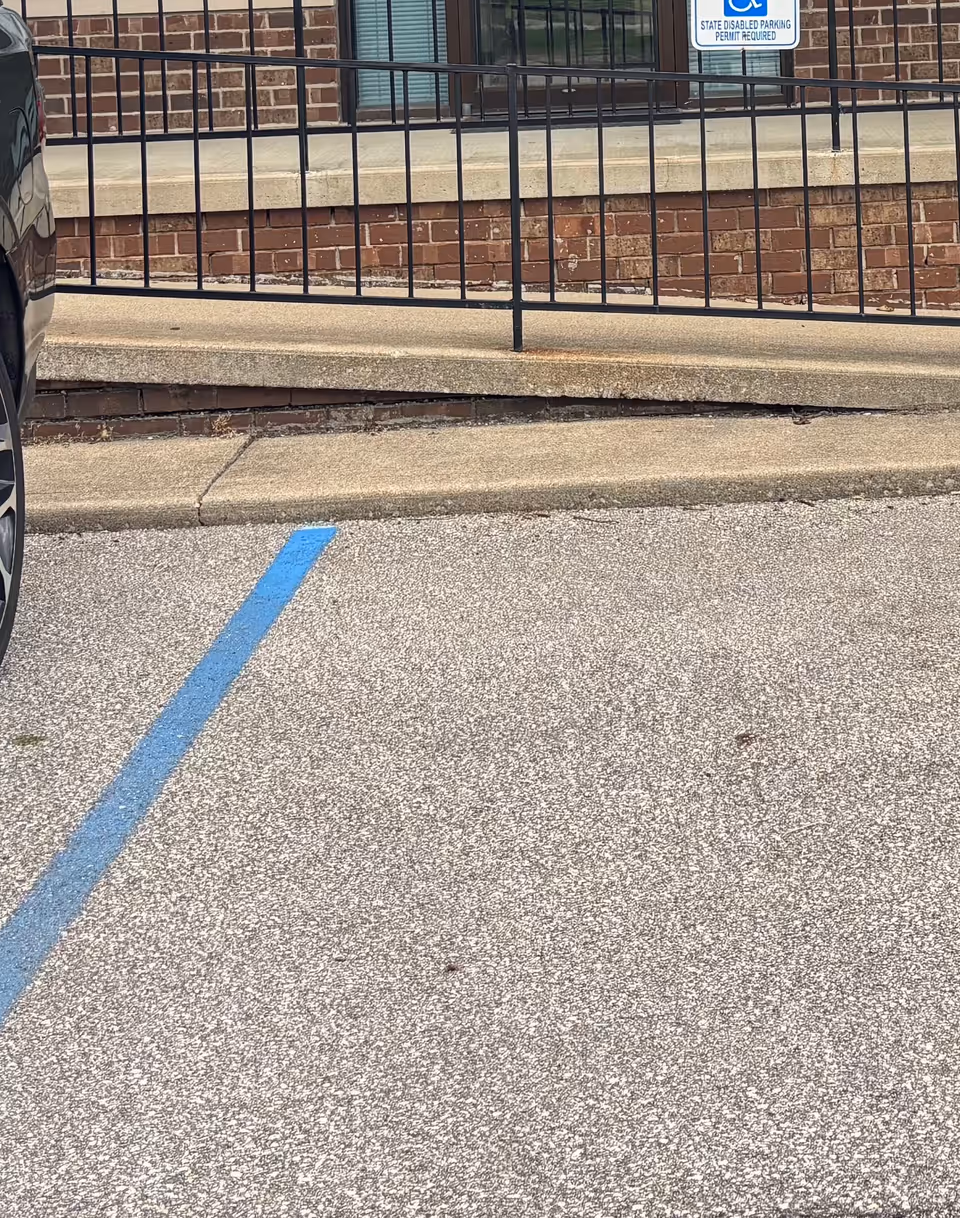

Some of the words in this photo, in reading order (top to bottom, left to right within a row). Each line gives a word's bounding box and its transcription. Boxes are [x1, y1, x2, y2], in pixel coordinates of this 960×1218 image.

[700, 20, 722, 30] STATE
[724, 20, 758, 30] DISABLED
[760, 19, 791, 29] PARKING
[715, 31, 740, 41] PERMIT
[741, 30, 776, 40] REQUIRED
